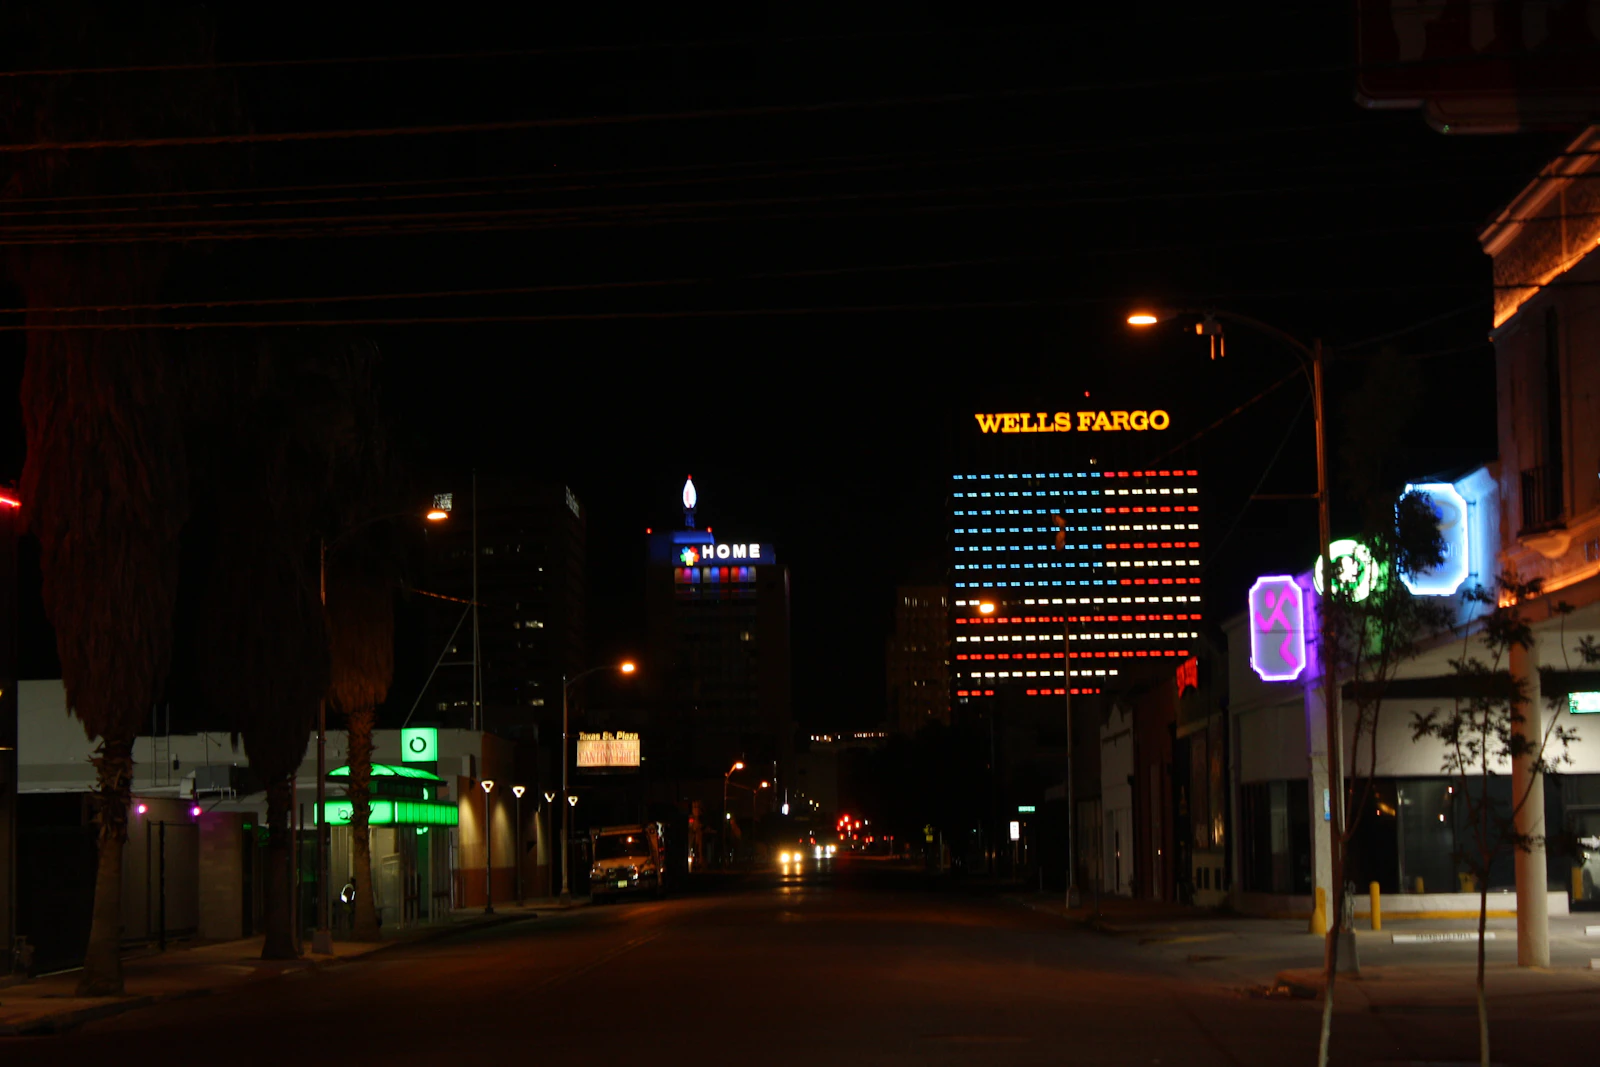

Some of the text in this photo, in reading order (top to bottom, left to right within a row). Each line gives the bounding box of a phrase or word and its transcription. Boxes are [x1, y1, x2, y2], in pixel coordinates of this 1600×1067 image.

[975, 410, 1170, 434] WELLS FARGO
[702, 543, 761, 559] HOME
[579, 731, 601, 741] Texas
[616, 730, 639, 741] Plaza
